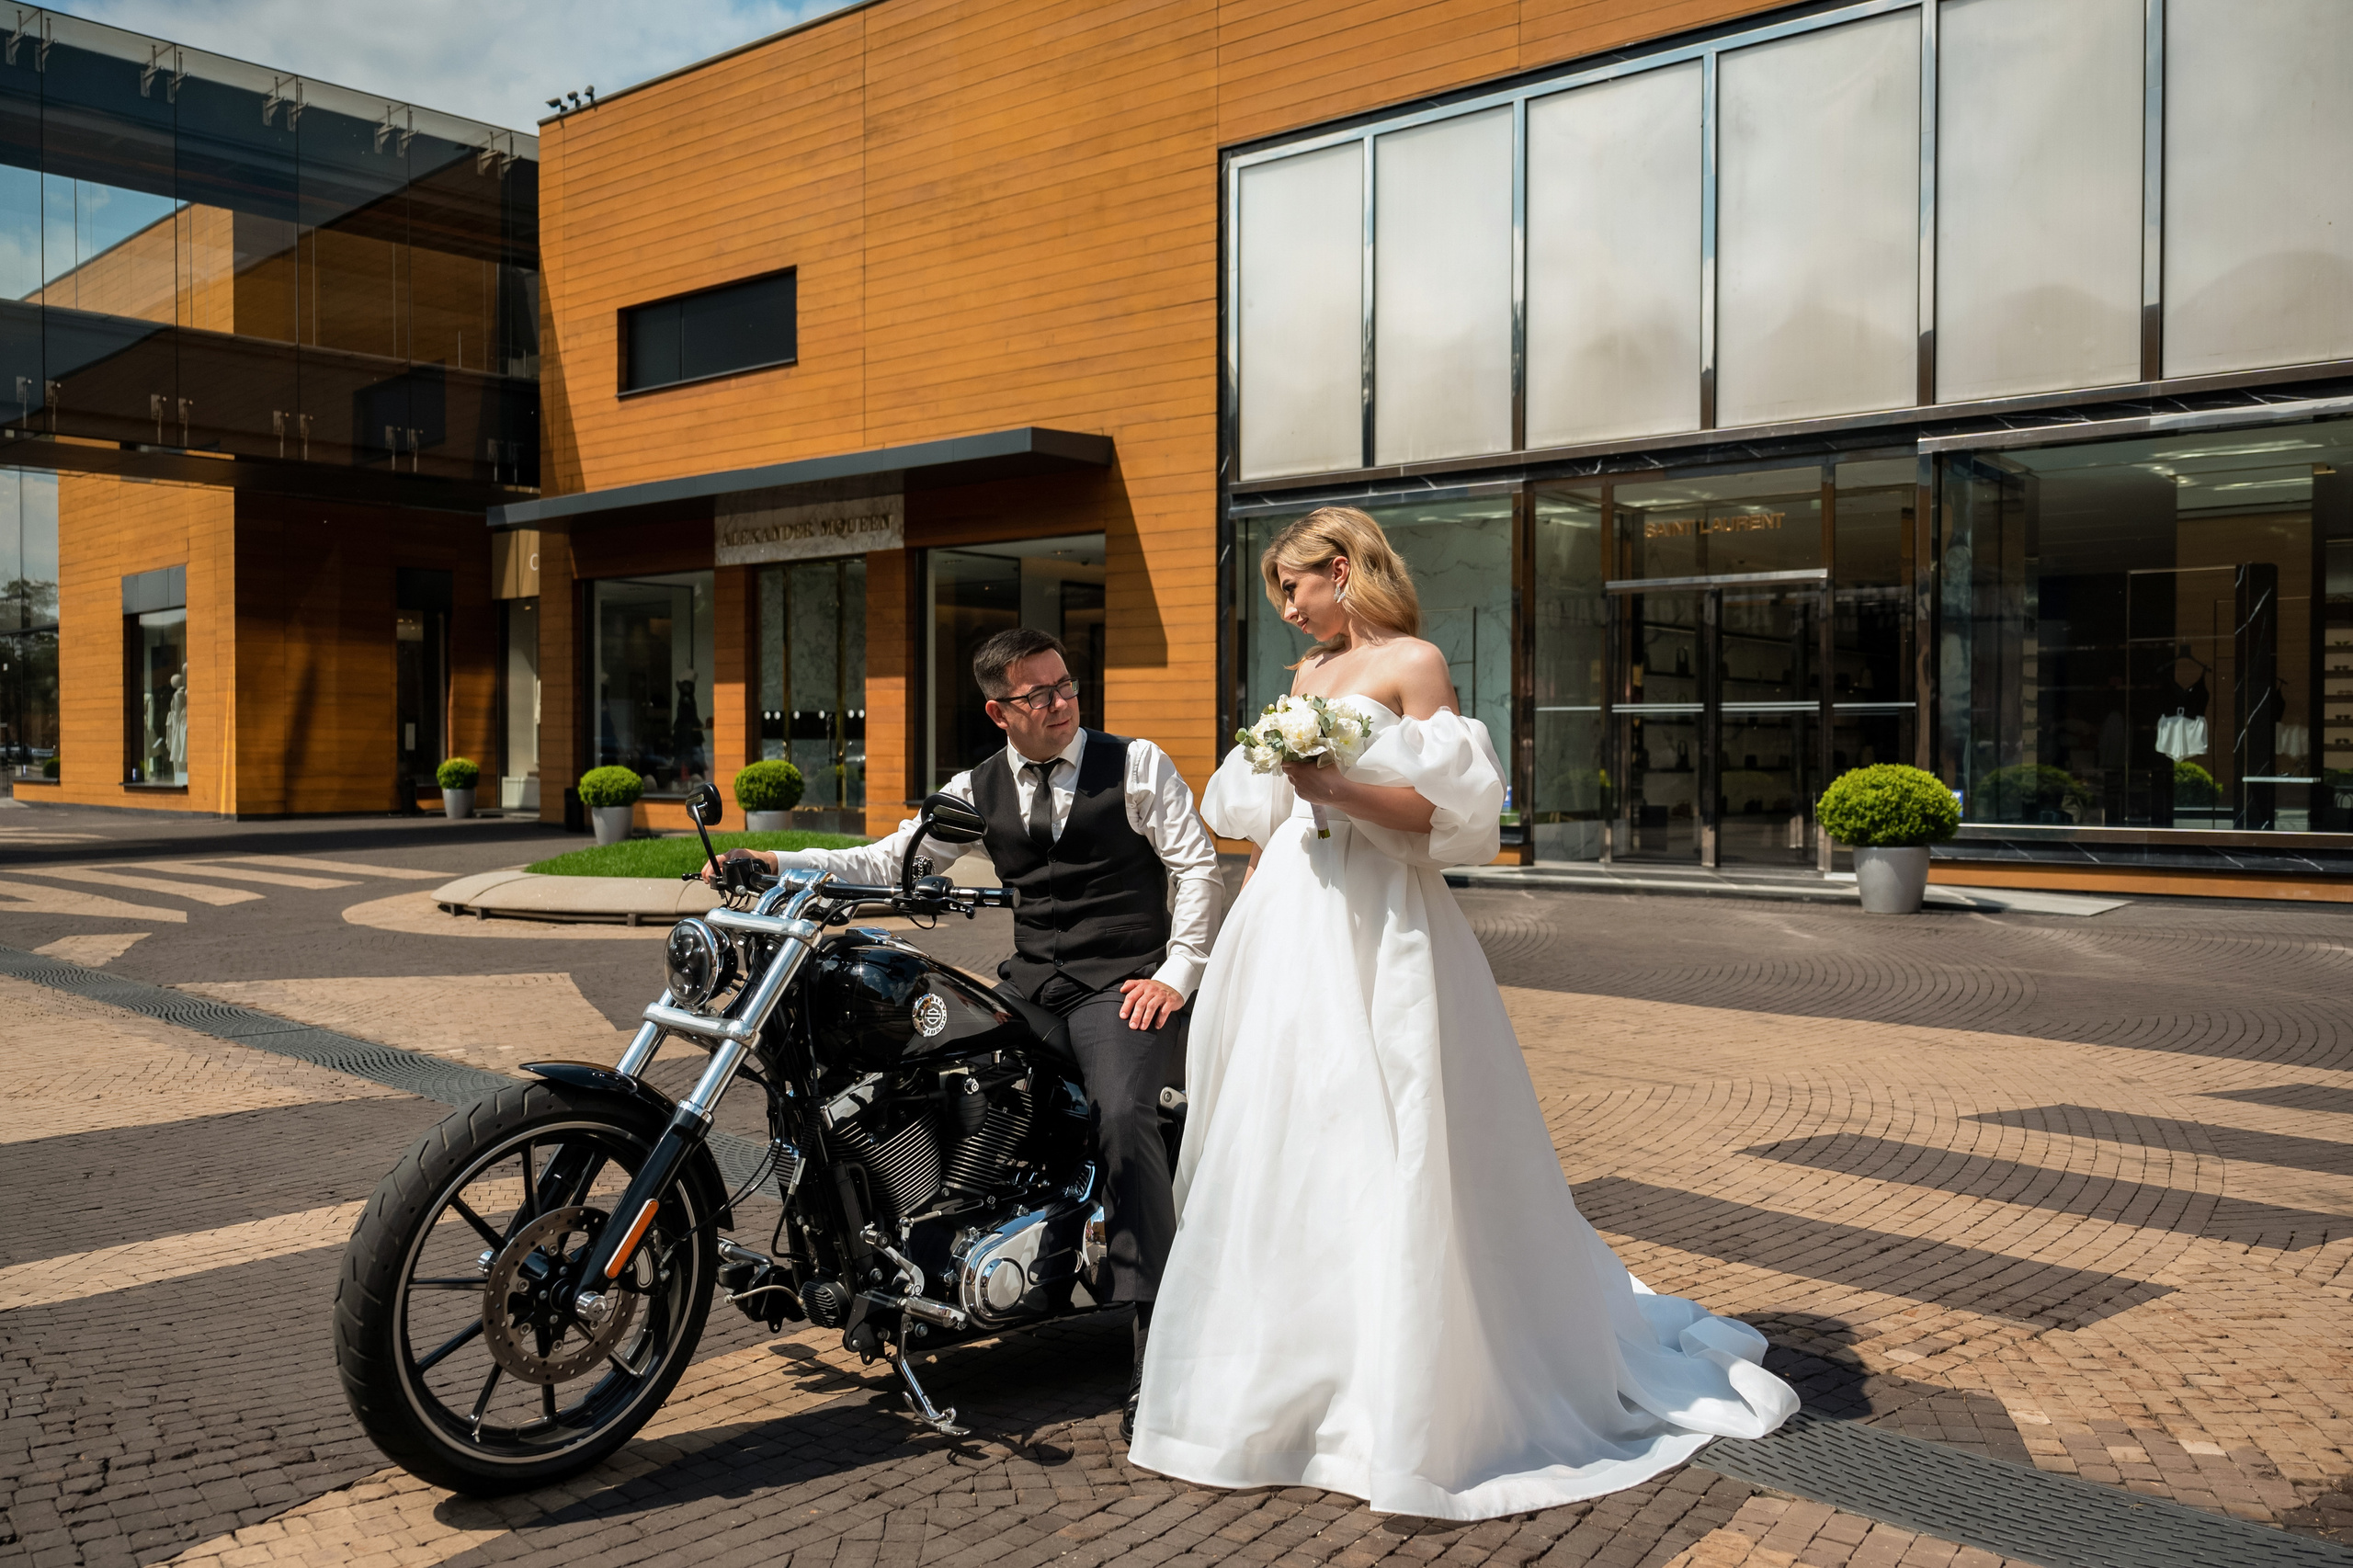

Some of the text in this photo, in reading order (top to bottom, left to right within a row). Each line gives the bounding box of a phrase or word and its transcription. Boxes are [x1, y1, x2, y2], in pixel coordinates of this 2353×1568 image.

[721, 523, 813, 548] ALEXANDER
[1644, 512, 1785, 538] SAINT LAURENT
